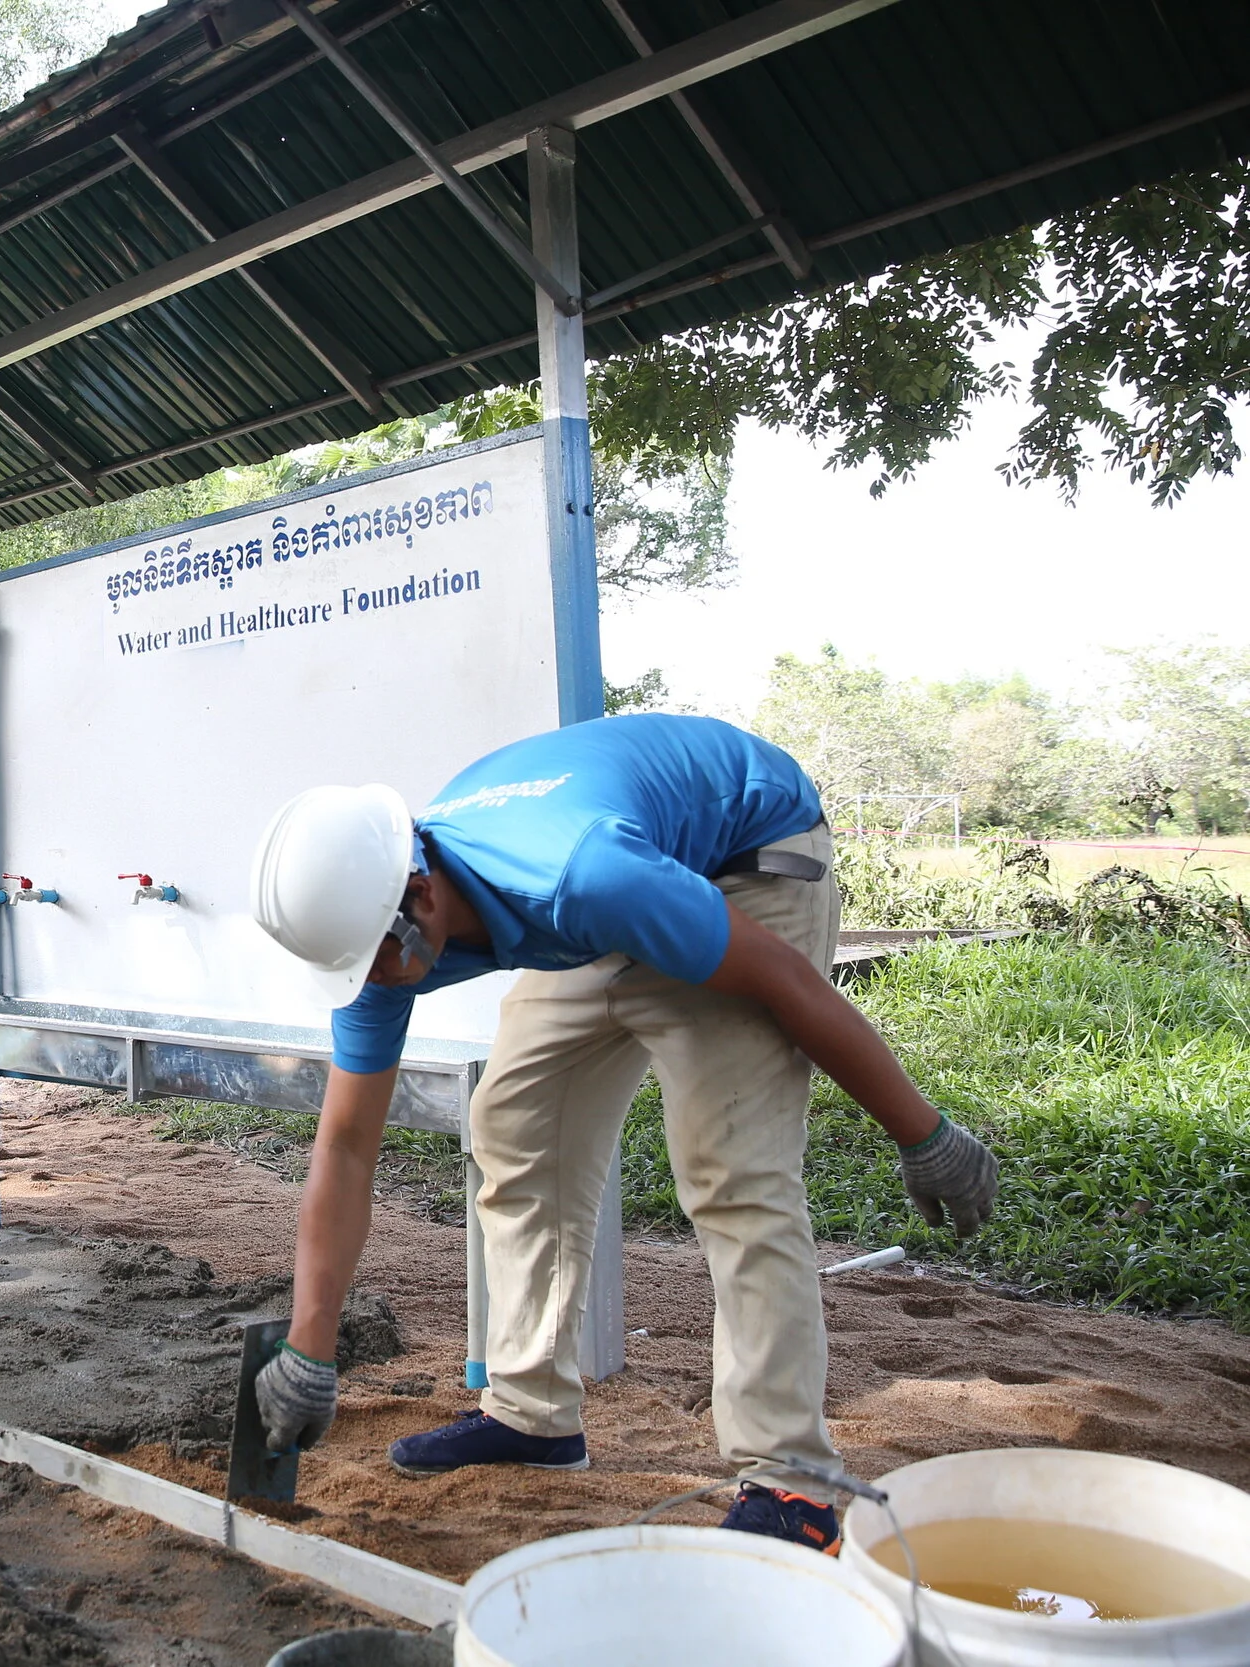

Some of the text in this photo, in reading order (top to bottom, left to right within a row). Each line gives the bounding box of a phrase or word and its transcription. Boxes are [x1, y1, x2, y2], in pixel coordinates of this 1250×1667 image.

[118, 567, 481, 656] Water and Healthcare Foundation
